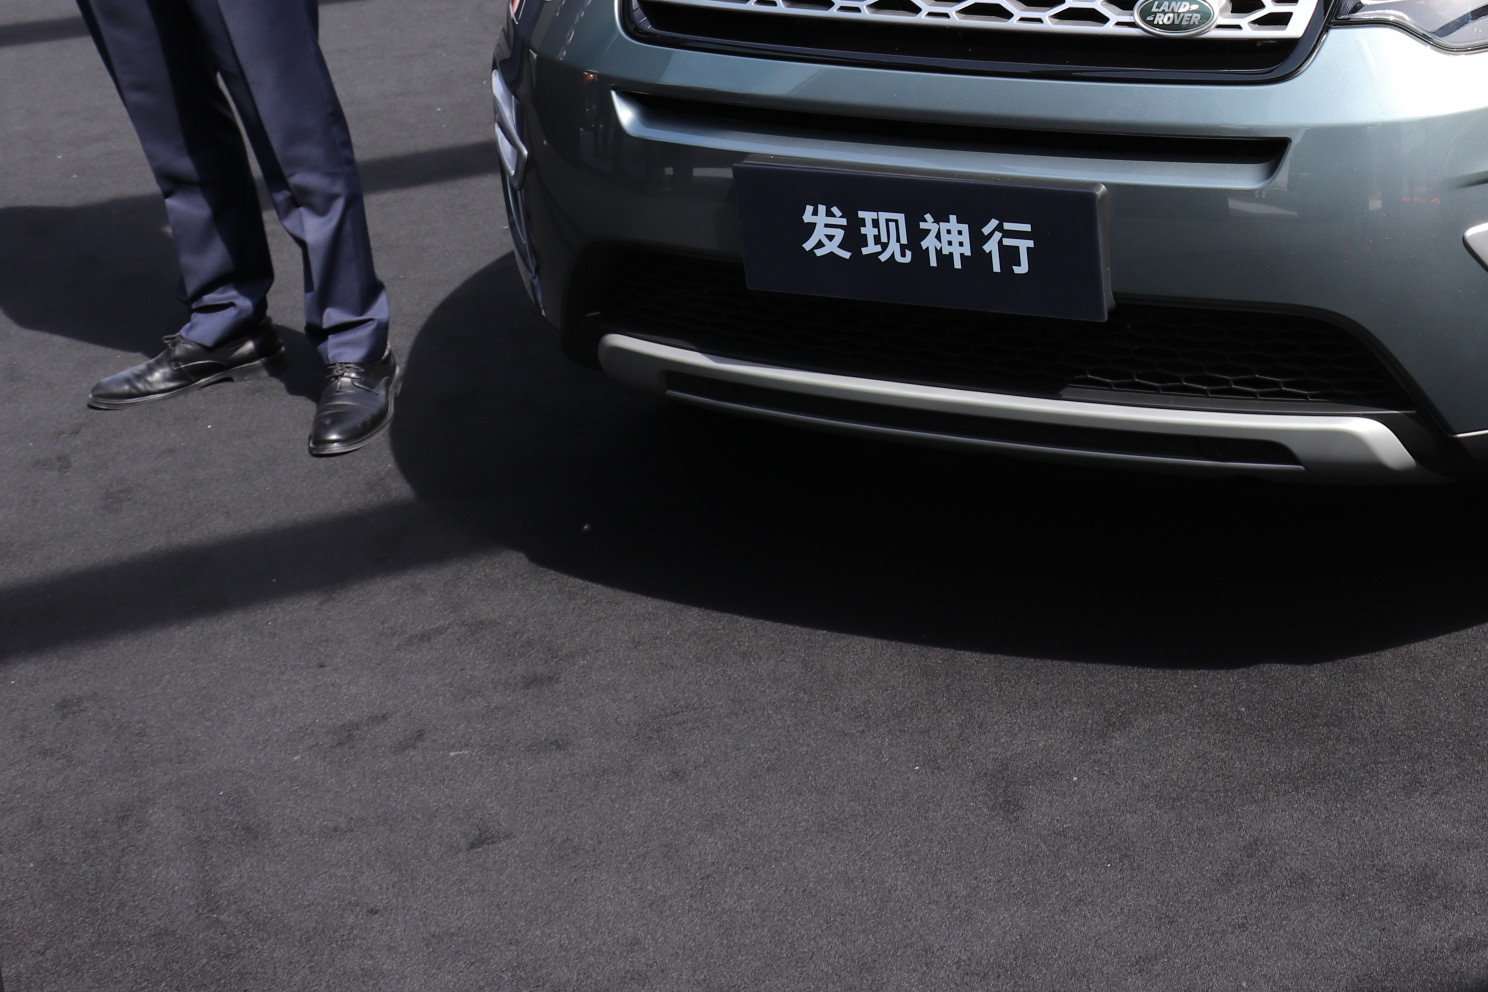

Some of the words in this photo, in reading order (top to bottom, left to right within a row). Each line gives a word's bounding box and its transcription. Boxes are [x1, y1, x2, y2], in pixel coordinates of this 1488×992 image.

[1151, 0, 1190, 13] LAND
[1153, 12, 1201, 25] ROVER
[801, 203, 1035, 274] 发现神行
